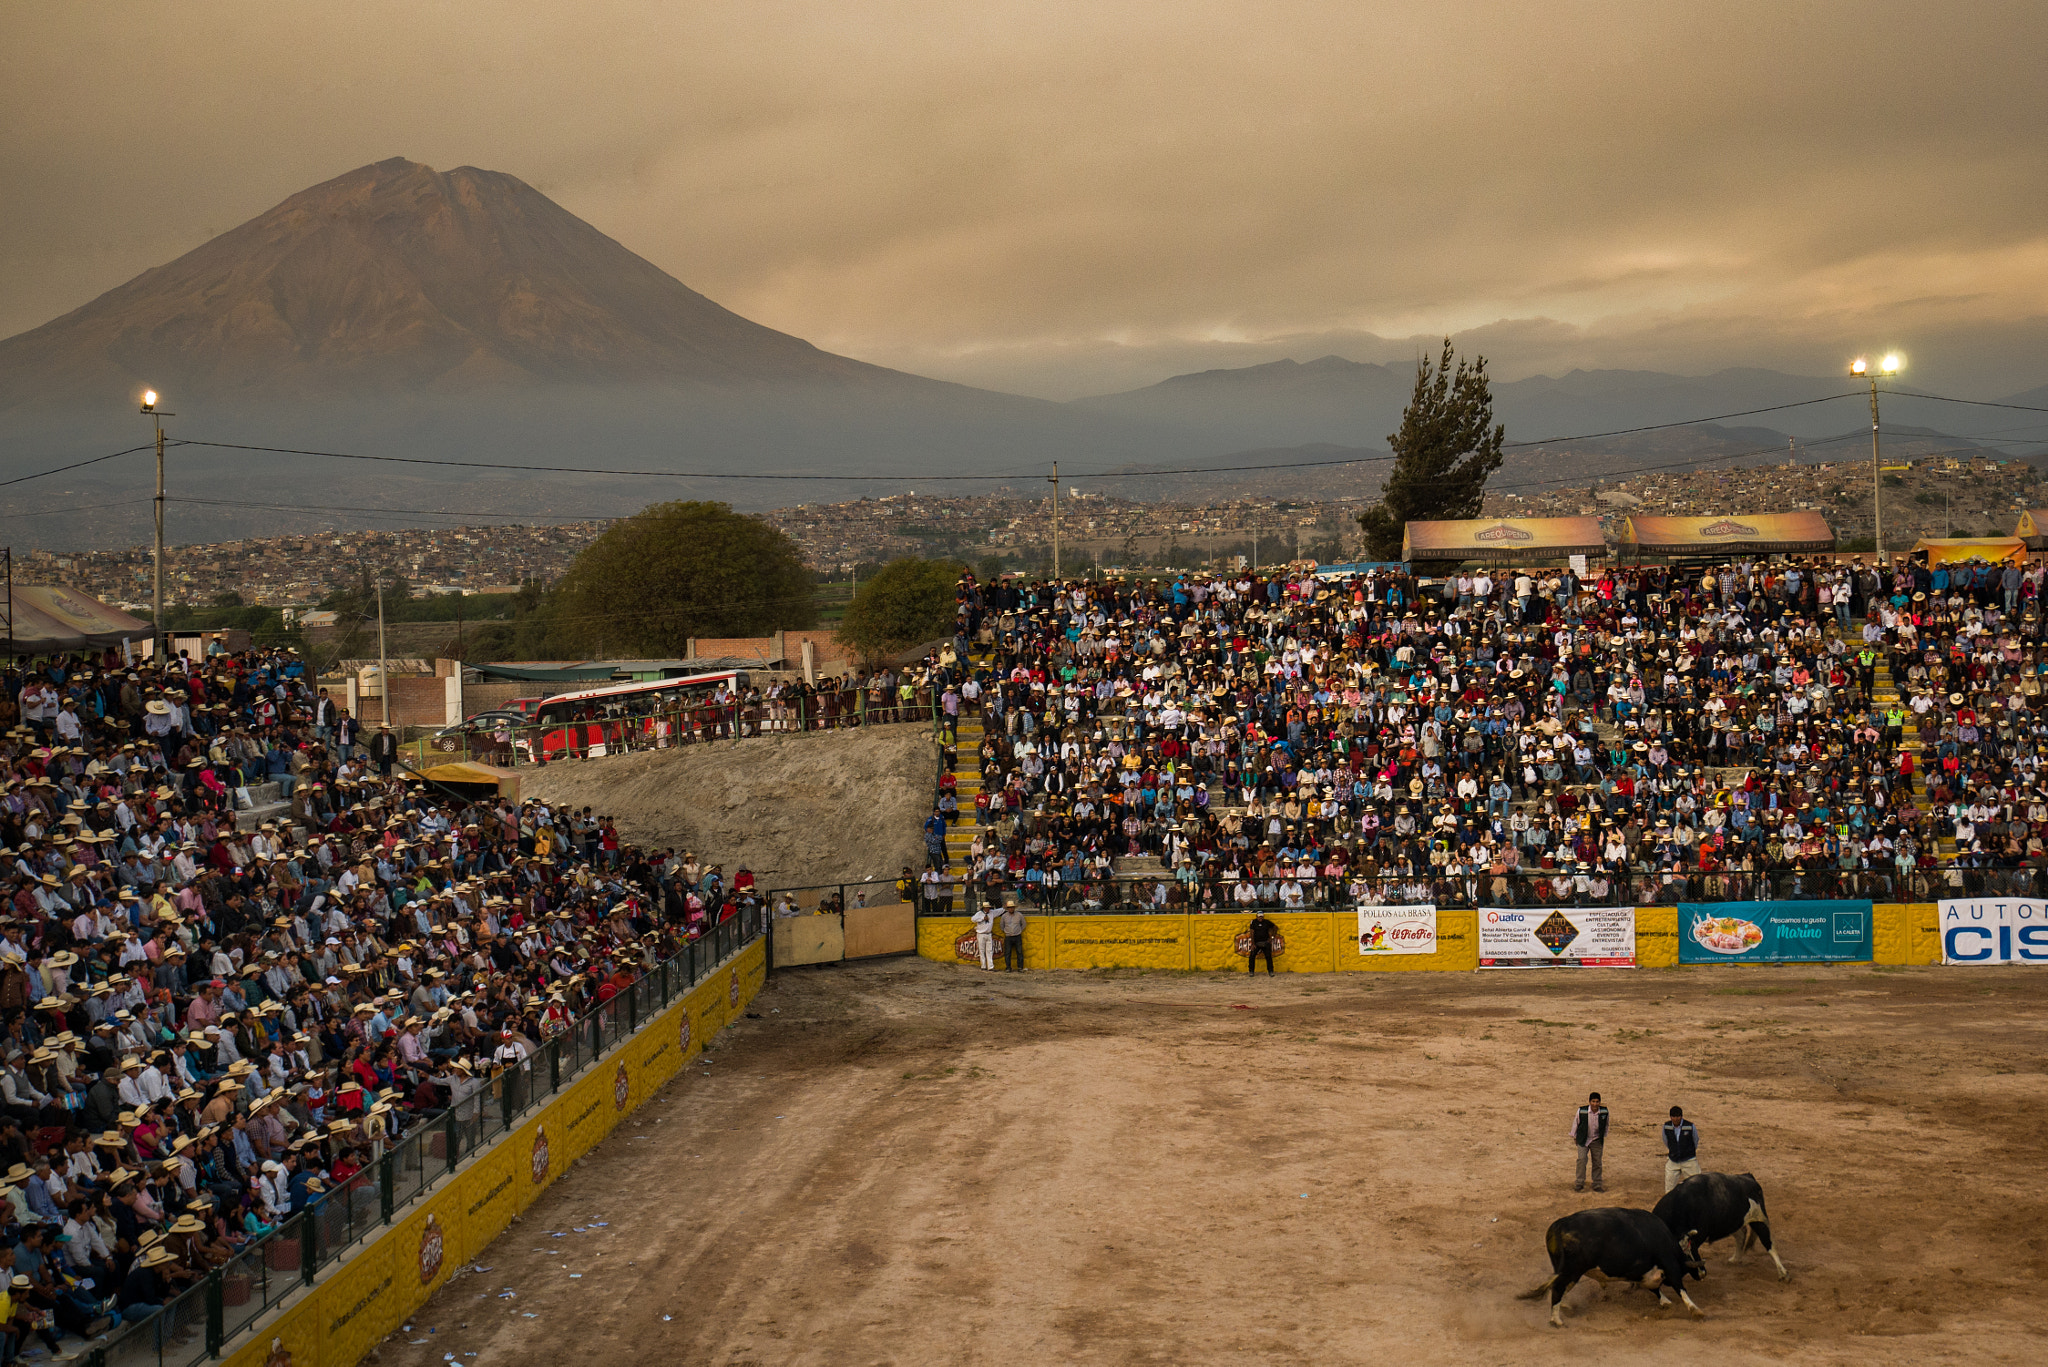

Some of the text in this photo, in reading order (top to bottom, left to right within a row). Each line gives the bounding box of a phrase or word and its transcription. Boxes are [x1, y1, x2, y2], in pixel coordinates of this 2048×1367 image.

[1363, 910, 1392, 918] POLLOS
[1407, 909, 1432, 917] BRASA
[1548, 918, 1566, 927] ALTO
[1809, 917, 1827, 925] gusto
[1776, 924, 1822, 939] Marino
